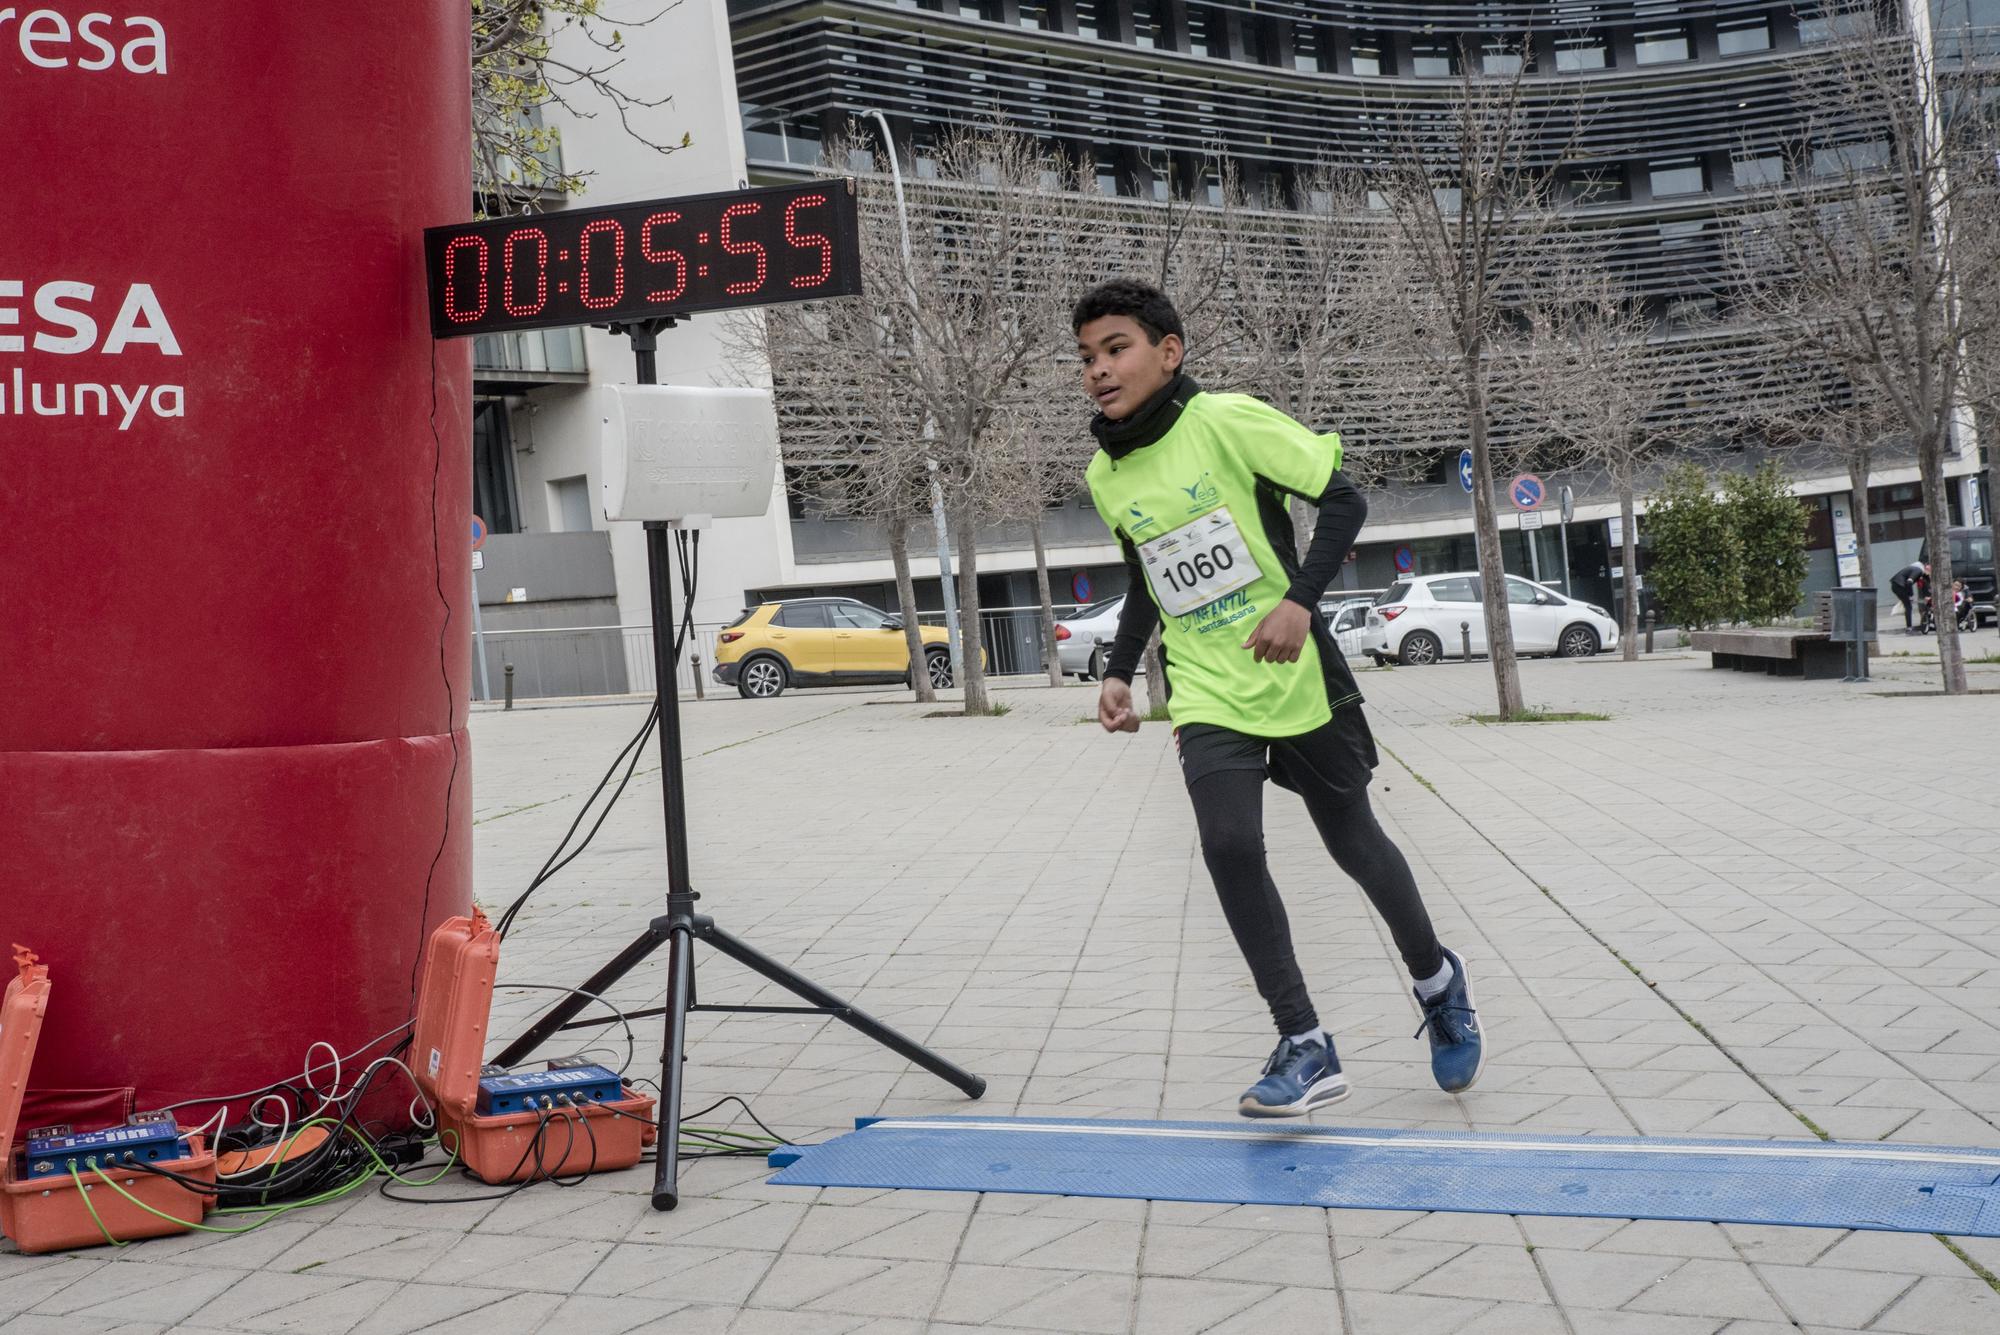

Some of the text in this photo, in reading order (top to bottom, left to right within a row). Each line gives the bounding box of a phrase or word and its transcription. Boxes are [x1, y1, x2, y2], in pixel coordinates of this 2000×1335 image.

[0, 8, 168, 75] esa
[445, 193, 834, 323] 00:05:55
[0, 367, 185, 431] lunya
[1162, 543, 1235, 593] 1060
